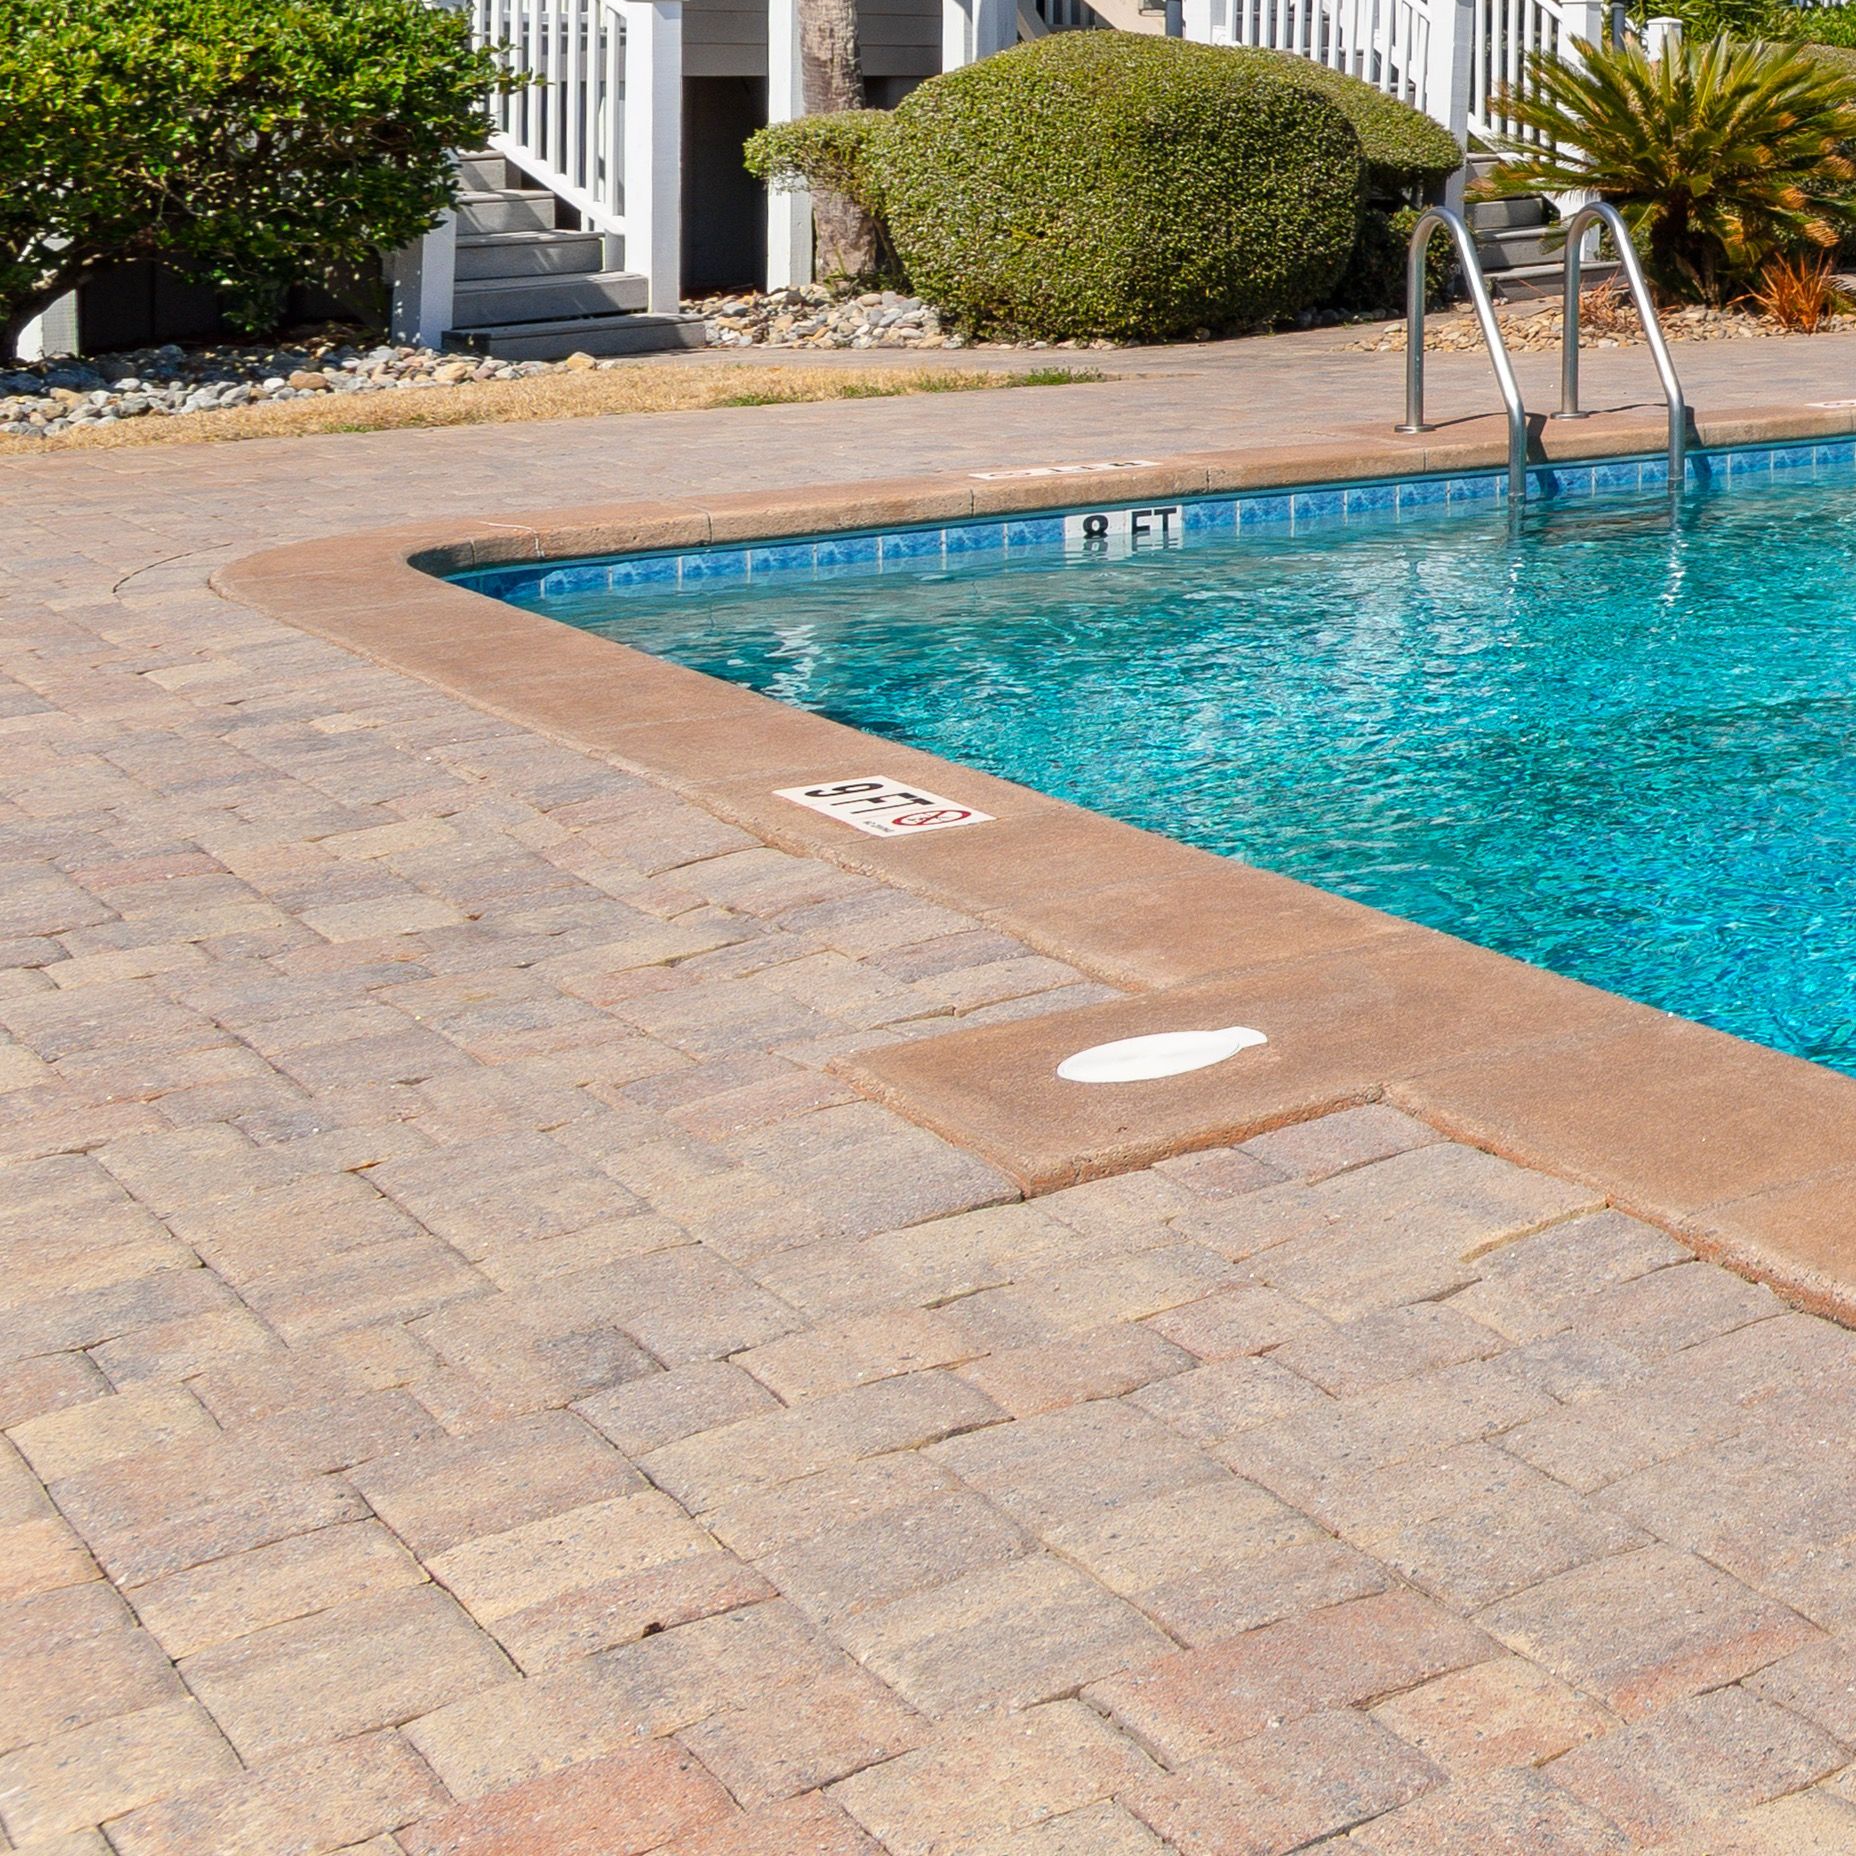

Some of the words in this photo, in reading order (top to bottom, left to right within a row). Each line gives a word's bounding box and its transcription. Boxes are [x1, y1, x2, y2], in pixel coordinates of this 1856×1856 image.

[1082, 514, 1109, 538] 8
[1131, 507, 1177, 535] FT
[804, 782, 884, 798] 9
[830, 792, 935, 814] FT
